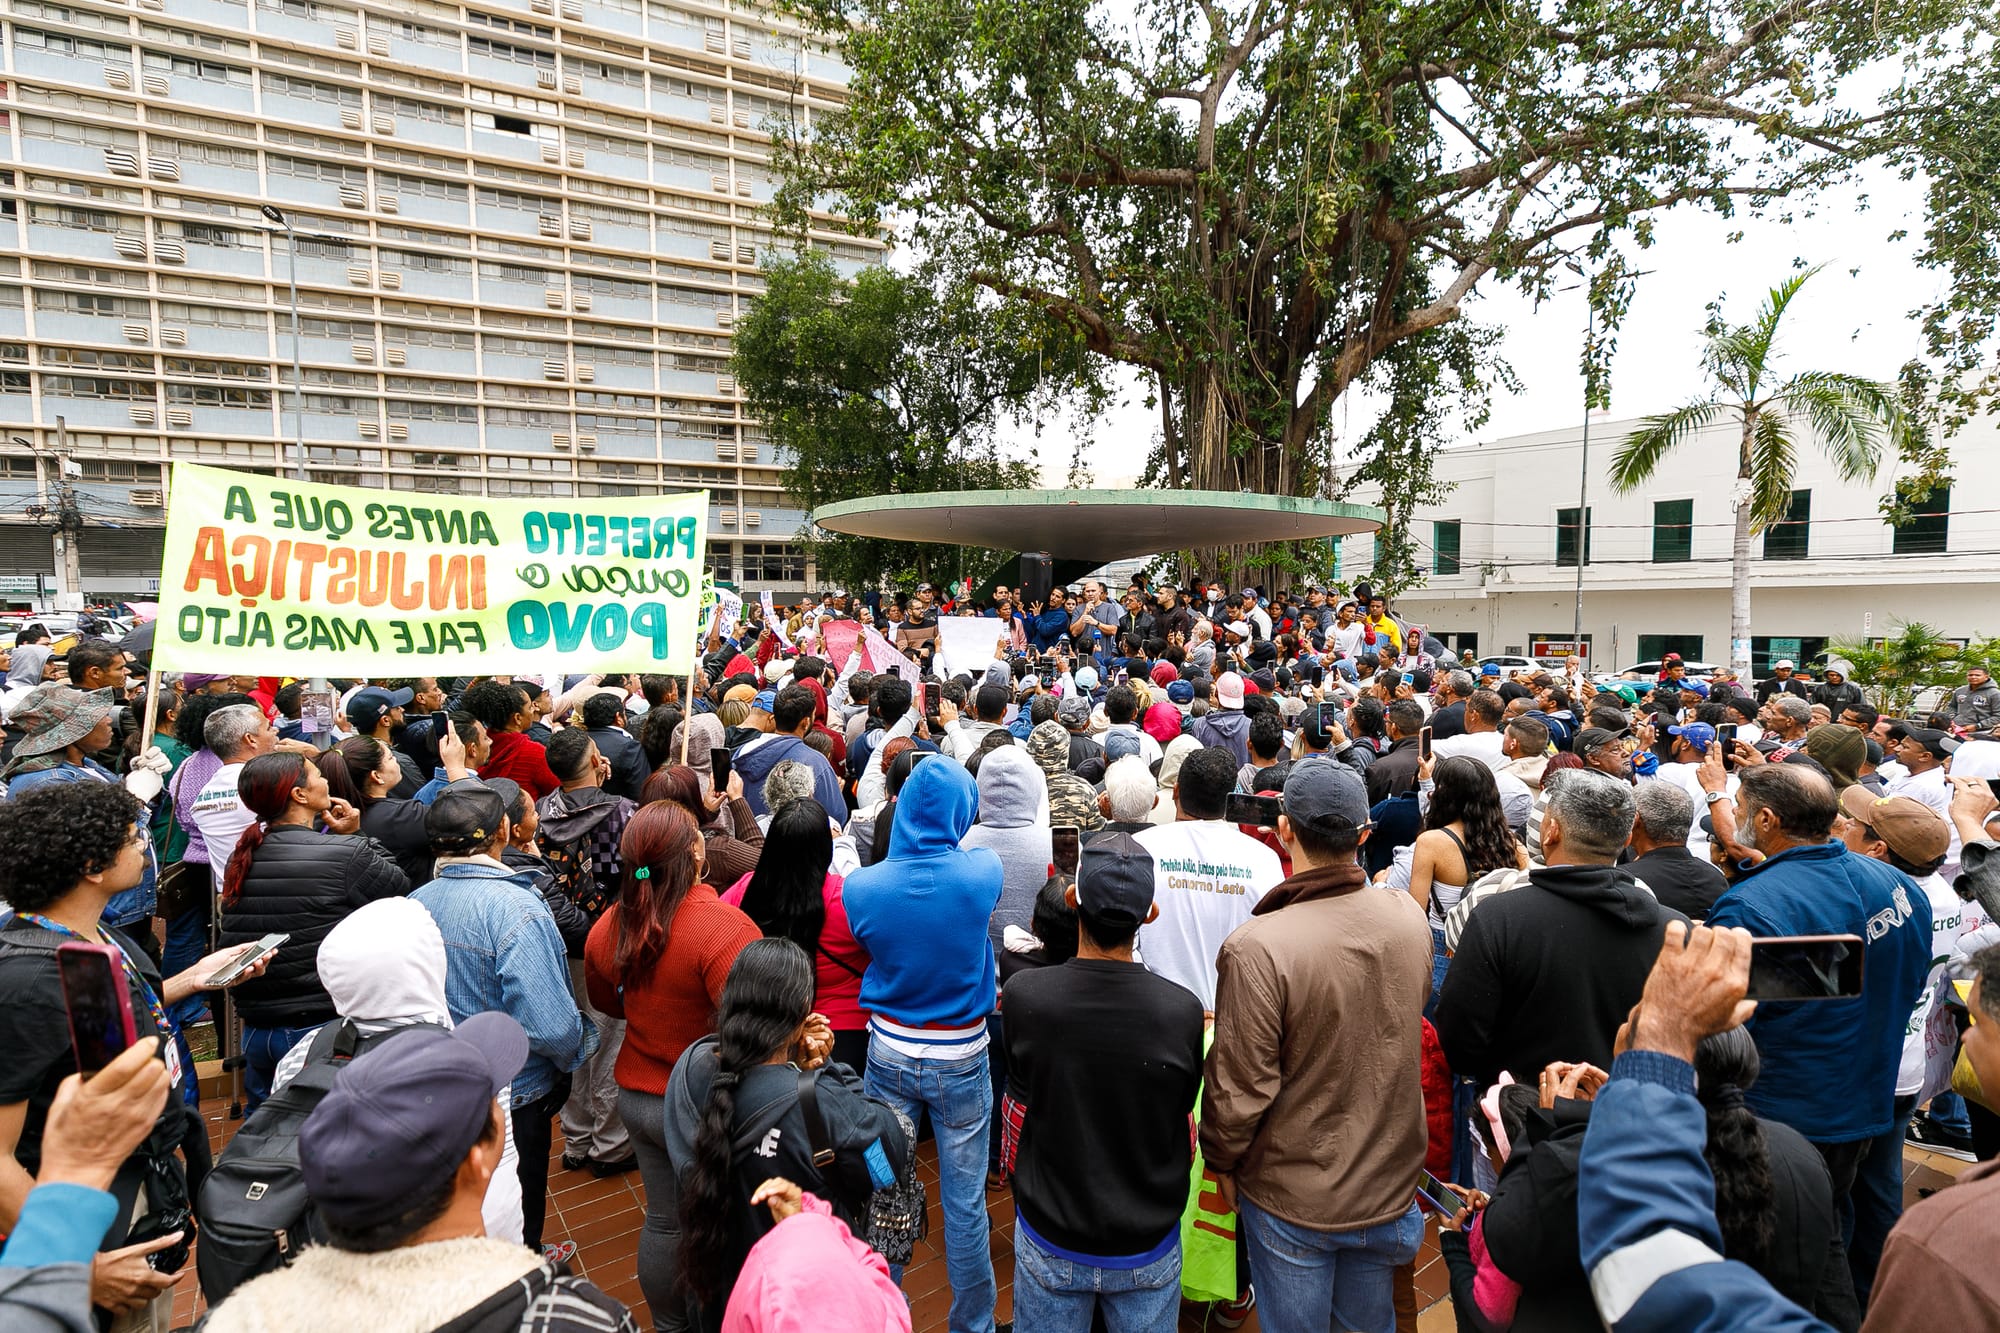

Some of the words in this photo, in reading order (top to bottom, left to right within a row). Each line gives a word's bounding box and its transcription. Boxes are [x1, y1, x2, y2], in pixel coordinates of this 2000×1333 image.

[1160, 858, 1182, 872] Prefeito
[1197, 860, 1215, 877] juntos
[1215, 863, 1228, 879] pelo
[1245, 866, 1252, 879] do
[1215, 880, 1246, 896] Leste
